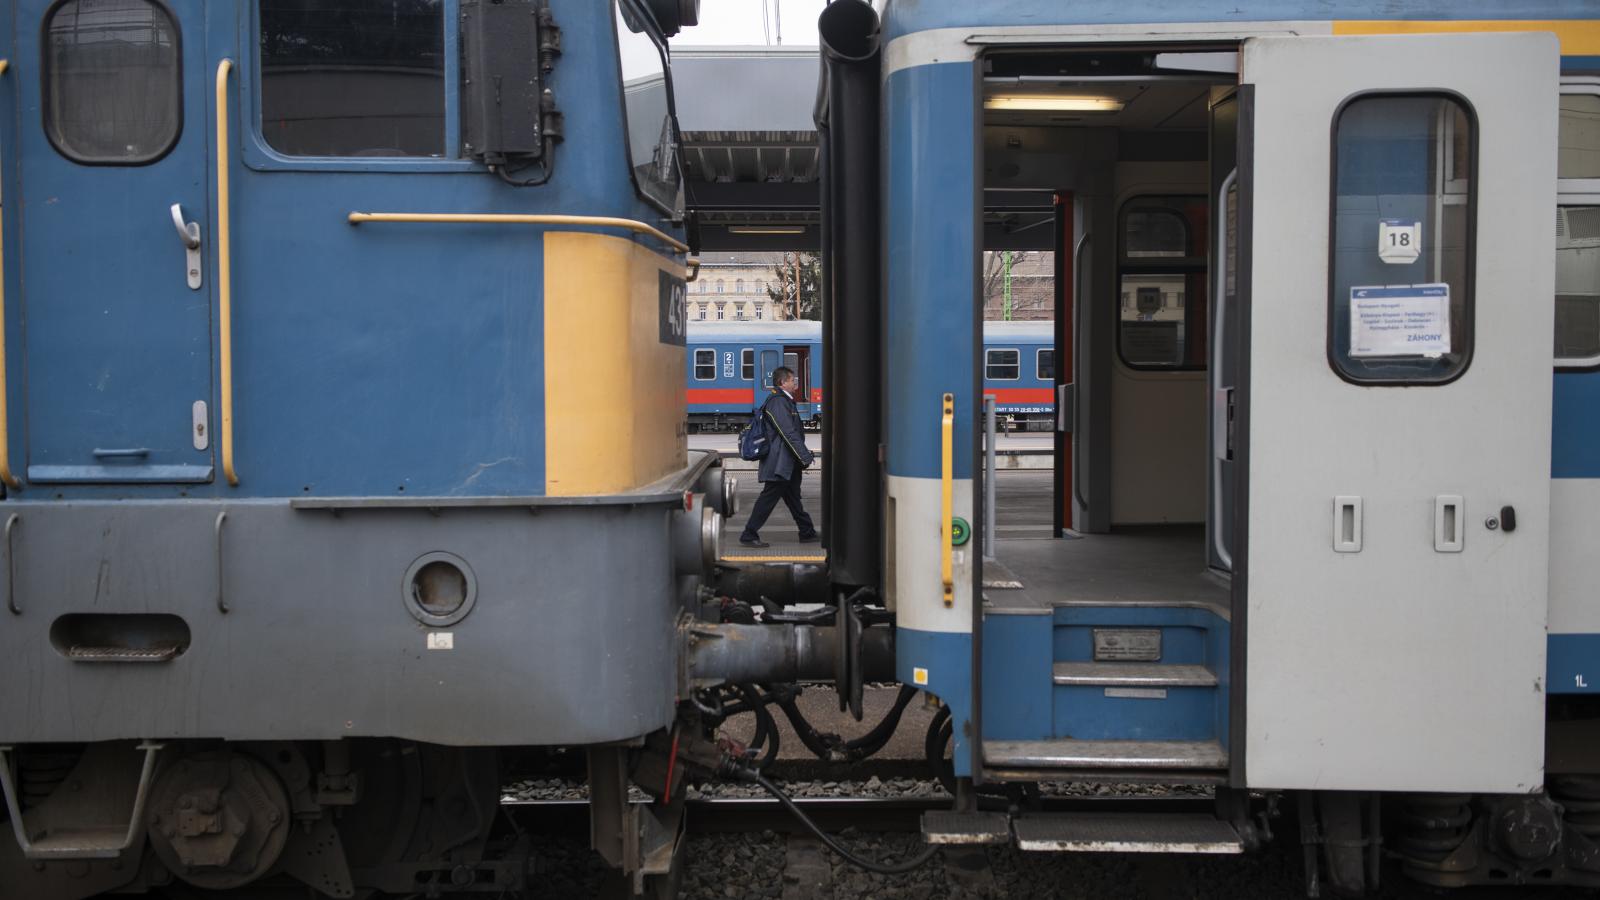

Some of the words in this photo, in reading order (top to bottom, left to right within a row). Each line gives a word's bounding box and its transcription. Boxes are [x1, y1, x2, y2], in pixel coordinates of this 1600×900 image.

[1389, 232, 1410, 247] 18
[1407, 333, 1442, 342] ZÁHONY
[726, 353, 732, 361] 2
[1575, 674, 1588, 688] 1L
